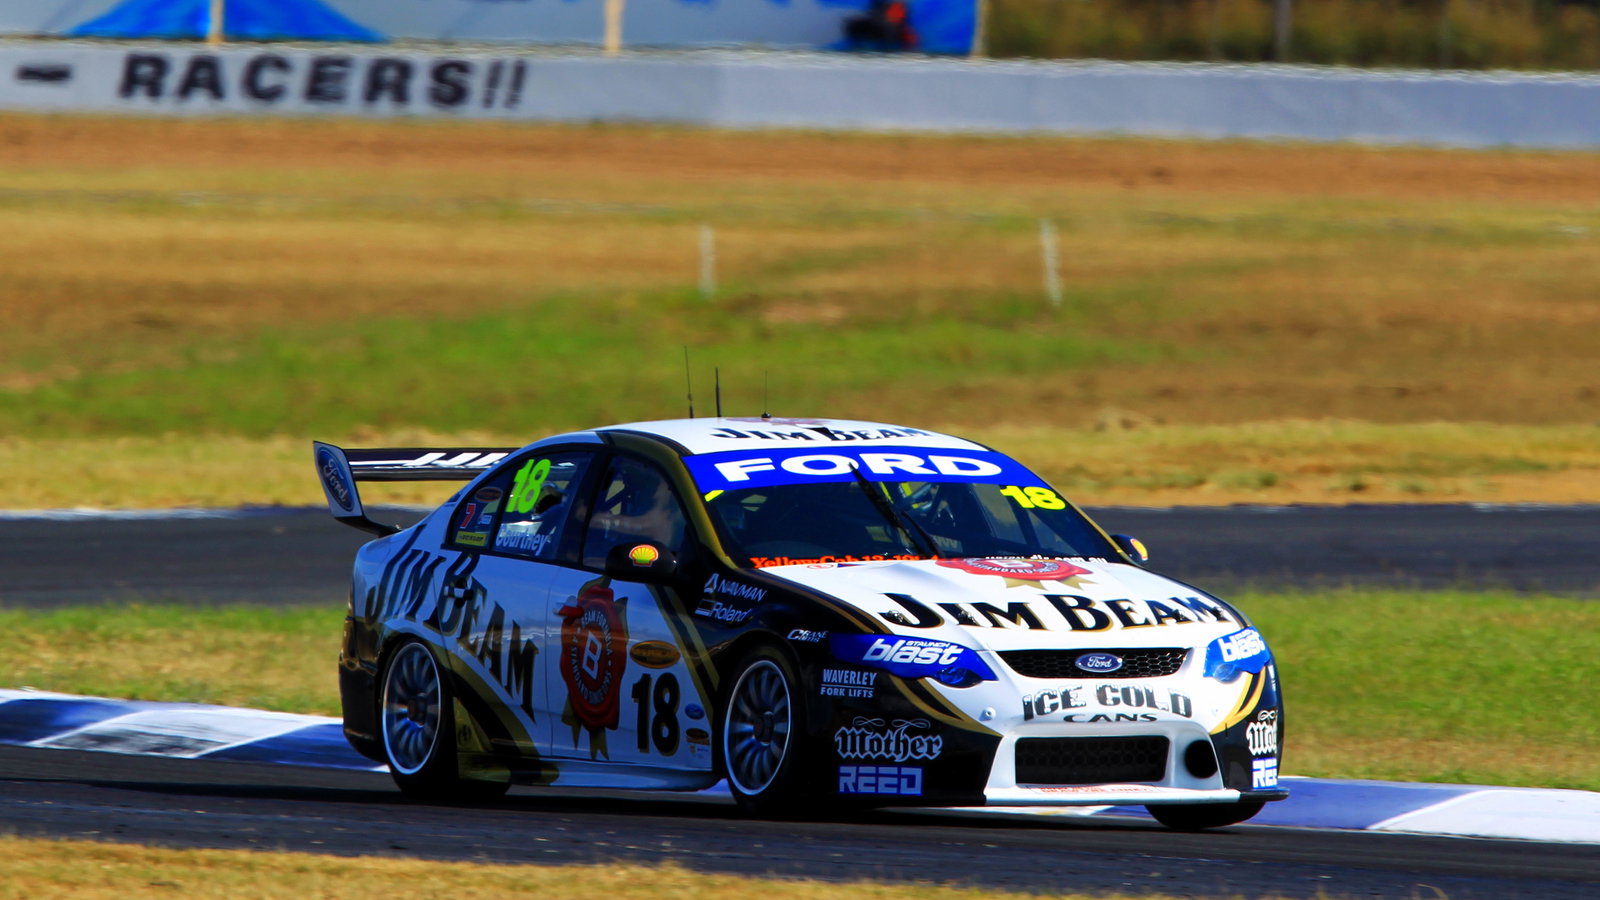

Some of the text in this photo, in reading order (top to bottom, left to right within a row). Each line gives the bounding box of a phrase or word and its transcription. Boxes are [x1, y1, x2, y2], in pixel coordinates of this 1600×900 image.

[117, 54, 528, 109] RACERS!!
[710, 427, 932, 442] JIM BEAM
[714, 453, 1003, 482] FORD
[505, 458, 551, 514] 18
[1000, 485, 1066, 511] 18
[718, 579, 768, 602] NAVMAN
[365, 523, 540, 725] JIM BEAM
[711, 602, 753, 622] Roland
[876, 592, 1233, 633] JIM BEAM
[863, 638, 965, 666] blast
[1086, 656, 1114, 669] Ford
[822, 669, 878, 686] WAVERLEY
[820, 687, 875, 698] FORK LIFTS
[1022, 683, 1193, 722] ICE COLD
[631, 672, 680, 758] 18
[1063, 713, 1158, 723] CANS
[834, 718, 943, 763] Mother
[838, 766, 923, 795] REED
